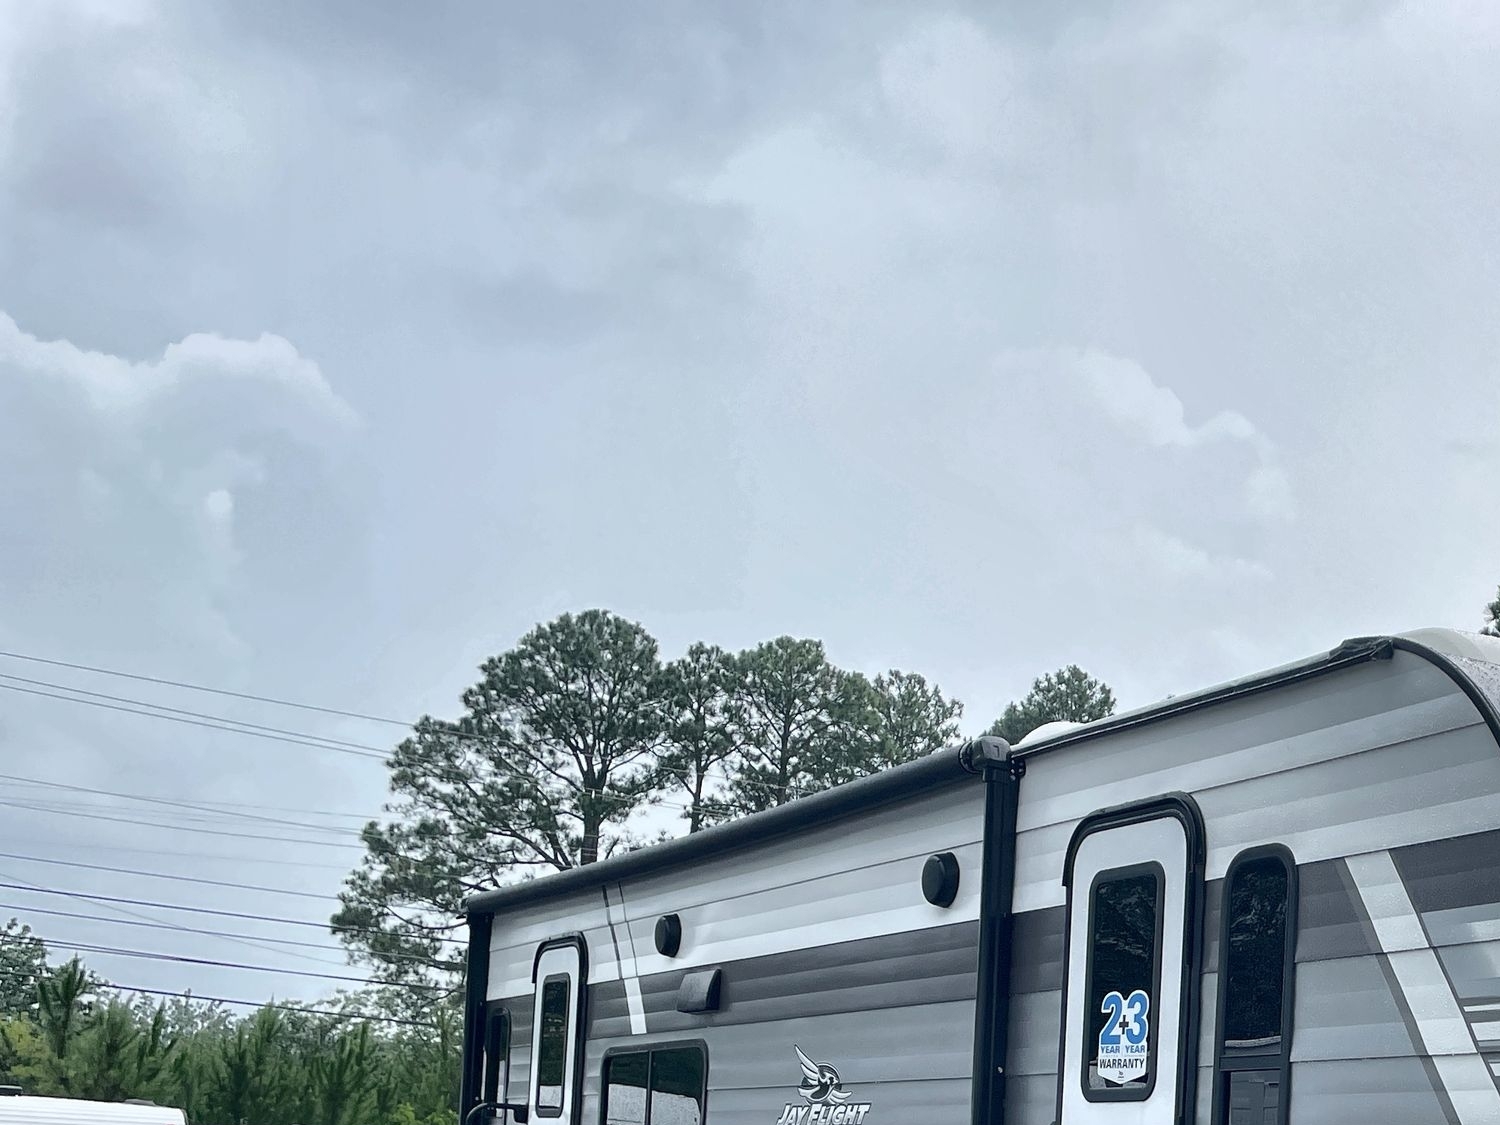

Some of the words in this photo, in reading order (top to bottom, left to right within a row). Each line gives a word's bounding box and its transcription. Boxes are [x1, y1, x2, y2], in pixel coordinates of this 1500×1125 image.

[1101, 1045, 1120, 1054] YEAR
[1125, 1044, 1145, 1054] YEAR
[1099, 1058, 1145, 1069] WARRANTY
